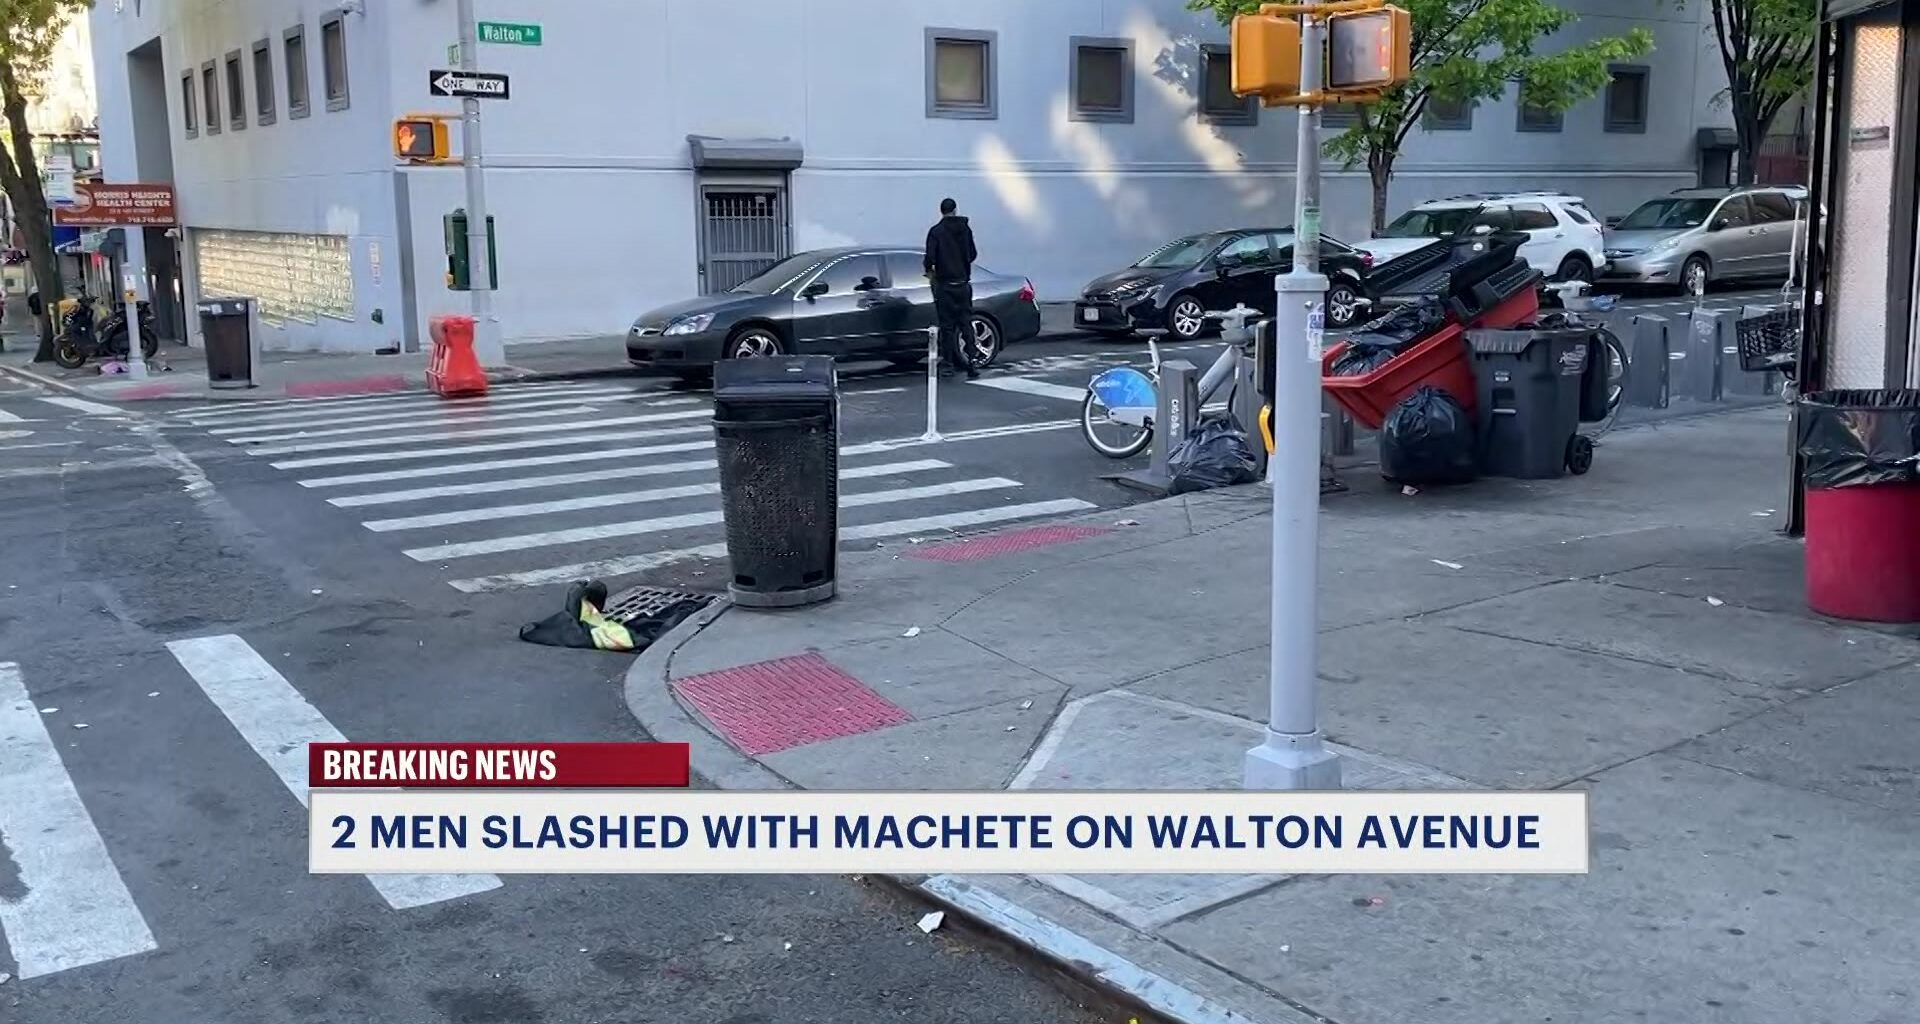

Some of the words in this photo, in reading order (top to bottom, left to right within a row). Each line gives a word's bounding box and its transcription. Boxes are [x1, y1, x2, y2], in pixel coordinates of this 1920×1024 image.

[483, 26, 522, 41] Walton
[442, 78, 464, 90] ONE
[476, 80, 500, 91] WAY
